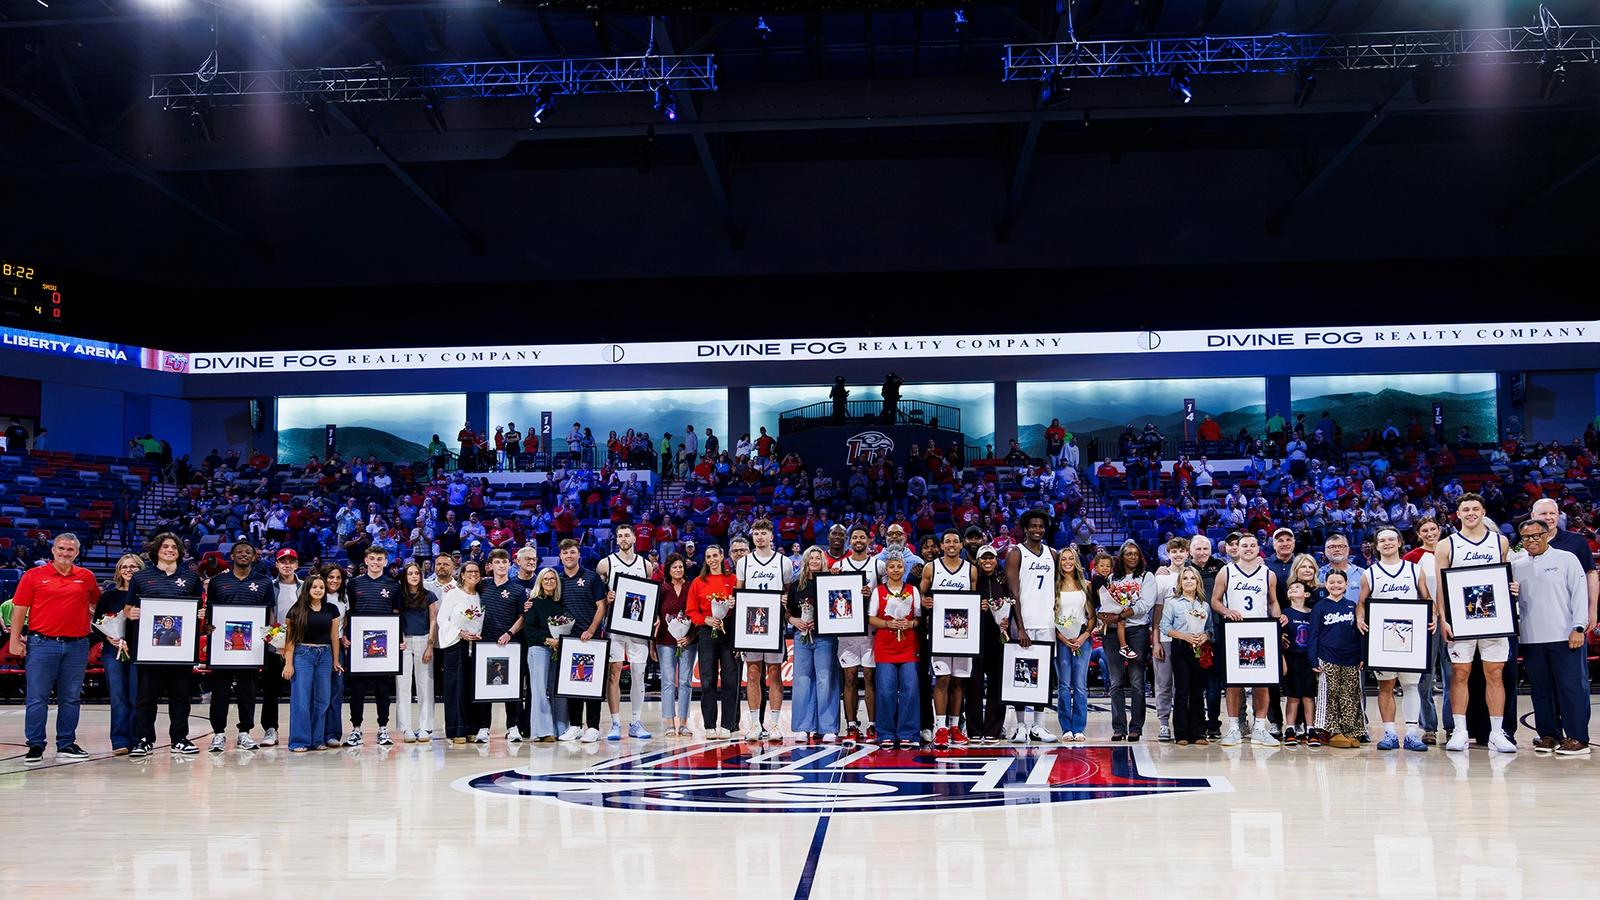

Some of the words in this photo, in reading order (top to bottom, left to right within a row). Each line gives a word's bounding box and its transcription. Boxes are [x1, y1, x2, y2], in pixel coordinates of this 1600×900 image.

[3, 264, 34, 279] 8:22
[52, 292, 60, 304] 0
[34, 306, 42, 314] 4
[53, 308, 60, 318] 0
[1207, 334, 1294, 347] DIVINE
[1304, 332, 1364, 345] FOG
[1375, 330, 1463, 341] REALTY
[1476, 327, 1586, 339] COMPANY
[3, 333, 70, 352] LIBERTY
[74, 344, 127, 361] ARENA
[697, 343, 781, 357] DIVINE
[790, 342, 847, 354] FOG
[858, 340, 943, 351] REALTY
[956, 338, 1062, 348] COMPANY
[194, 356, 274, 369] DIVINE
[283, 354, 337, 368] FOG
[348, 353, 428, 364] REALTY
[440, 350, 542, 362] COMPANY
[542, 416, 550, 434] 12
[1464, 552, 1494, 562] Liberty
[1029, 562, 1050, 572] Liberty
[752, 570, 775, 580] Liberty
[939, 578, 965, 590] Liberty
[1037, 575, 1044, 590] 7
[1234, 582, 1262, 594] Liberty
[1380, 584, 1410, 594] Liberty
[1244, 596, 1253, 610] 3
[1324, 612, 1354, 626] Liberty
